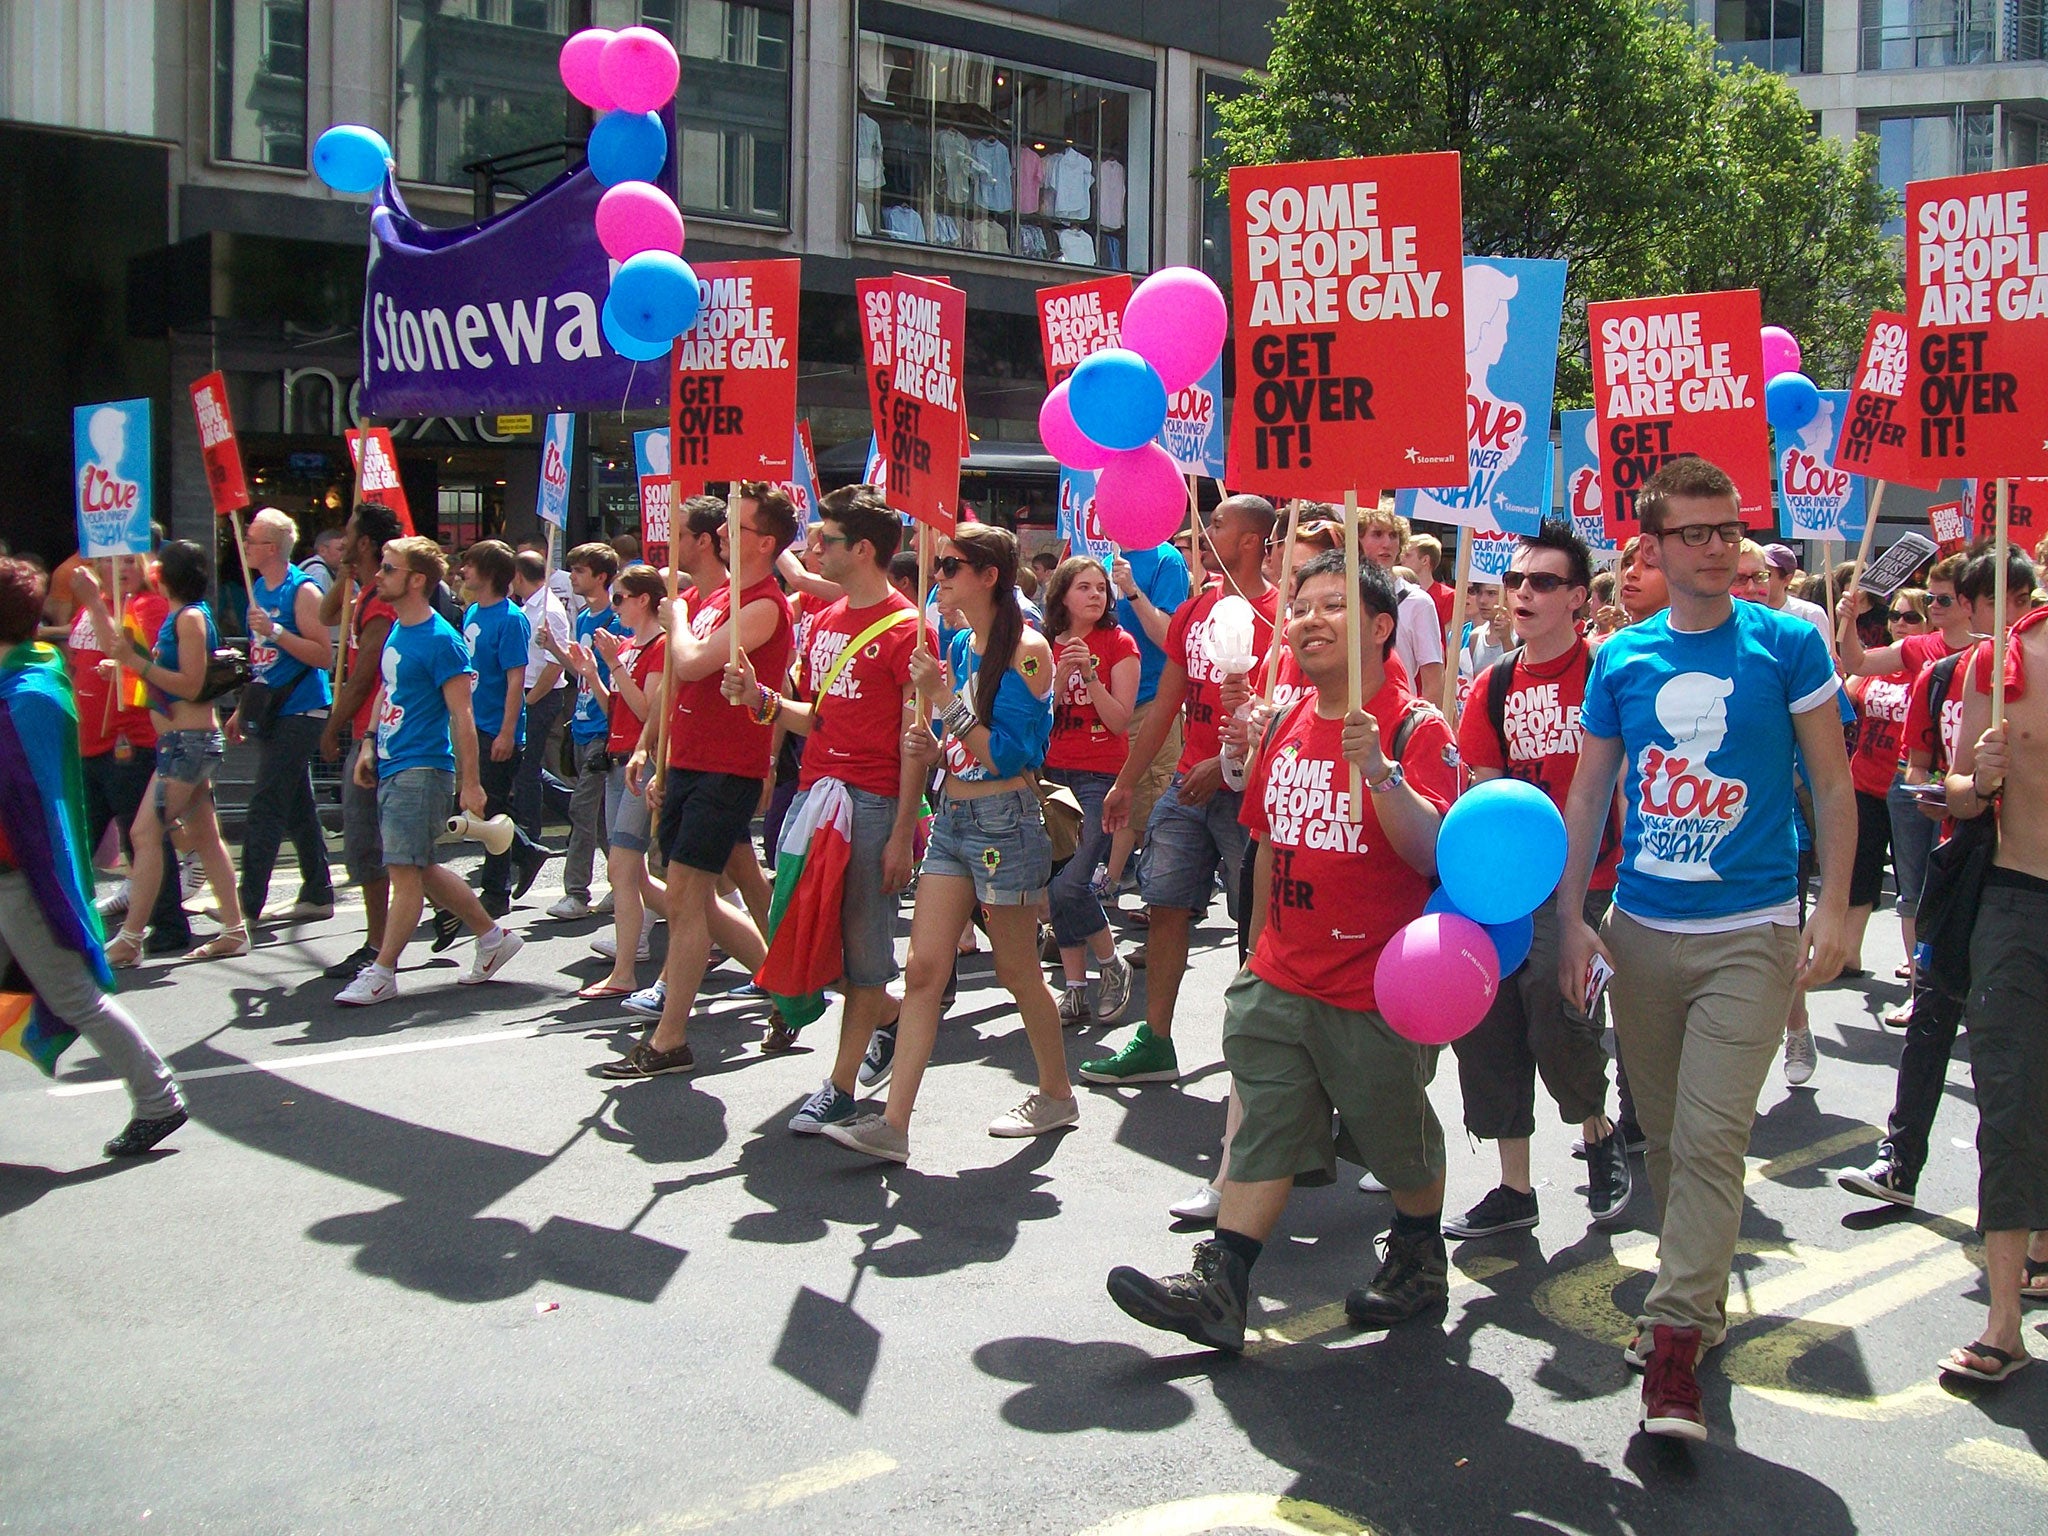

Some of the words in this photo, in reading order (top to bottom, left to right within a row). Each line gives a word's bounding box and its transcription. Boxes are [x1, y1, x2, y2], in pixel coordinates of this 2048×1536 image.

[1246, 181, 1379, 236] SOME
[1918, 190, 2028, 245] SOME
[1248, 226, 1418, 281] PEOPLE
[698, 277, 753, 310] OME
[1044, 292, 1102, 323] SOME
[1249, 277, 1340, 326] ARE
[1346, 271, 1450, 322] GAY.
[1918, 280, 1992, 328] ARE
[1997, 276, 2048, 321] GA
[896, 291, 942, 336] SOME
[1047, 311, 1120, 345] PEOPLE
[1601, 312, 1702, 353] SOME
[679, 340, 727, 371] ARE
[730, 338, 790, 370] GAY.
[896, 325, 952, 375] PEOPLE
[1252, 332, 1336, 379] GET
[1604, 343, 1732, 385] PEOPLE
[1866, 345, 1908, 372] PEO
[1920, 331, 1988, 375] GET
[679, 376, 724, 405] GET
[894, 358, 925, 399] ARE
[925, 368, 958, 412] GAY.
[1607, 383, 1675, 419] ARE
[1679, 374, 1756, 413] GAY.
[1859, 368, 1907, 397] ARE
[1919, 372, 2018, 417] OVER
[893, 397, 921, 437] GET
[1253, 377, 1376, 425] OVER
[1856, 394, 1898, 421] GET
[679, 405, 744, 436] OVER
[1164, 420, 1183, 433] YOUR
[1184, 421, 1206, 436] INNER
[1850, 417, 1908, 448] OVER
[1920, 416, 1968, 458] IT!
[679, 436, 709, 466] IT!
[891, 430, 931, 474] OVER
[1255, 424, 1312, 470] IT!
[1610, 420, 1673, 456] GET
[1843, 437, 1874, 465] IT!
[1416, 454, 1455, 465] Stonewall
[1785, 449, 1849, 496] Love
[83, 465, 137, 512] Love
[644, 484, 673, 504] SOM
[891, 463, 911, 498] IT!
[1983, 481, 2019, 503] GT
[85, 511, 105, 524] YOUR
[105, 510, 130, 522] INNER
[1787, 496, 1813, 507] YOUR
[1814, 496, 1842, 508] INNER
[1932, 507, 1959, 520] SOME
[1982, 502, 2033, 528] OER
[1933, 516, 1964, 533] PEOPL
[1937, 529, 1956, 543] ARE
[1473, 540, 1493, 552] OUR
[1888, 546, 1919, 566] NEVER
[251, 648, 277, 664] ove
[1504, 706, 1580, 742] PEOPLE
[1510, 734, 1547, 761] ARE
[1268, 757, 1335, 791] SOME
[1641, 748, 1745, 820] Love
[1264, 785, 1351, 823] PEOPLE
[1305, 819, 1369, 854] GAY.
[1675, 818, 1726, 834] INNER
[1271, 847, 1296, 878] ET
[1271, 877, 1315, 911] VER
